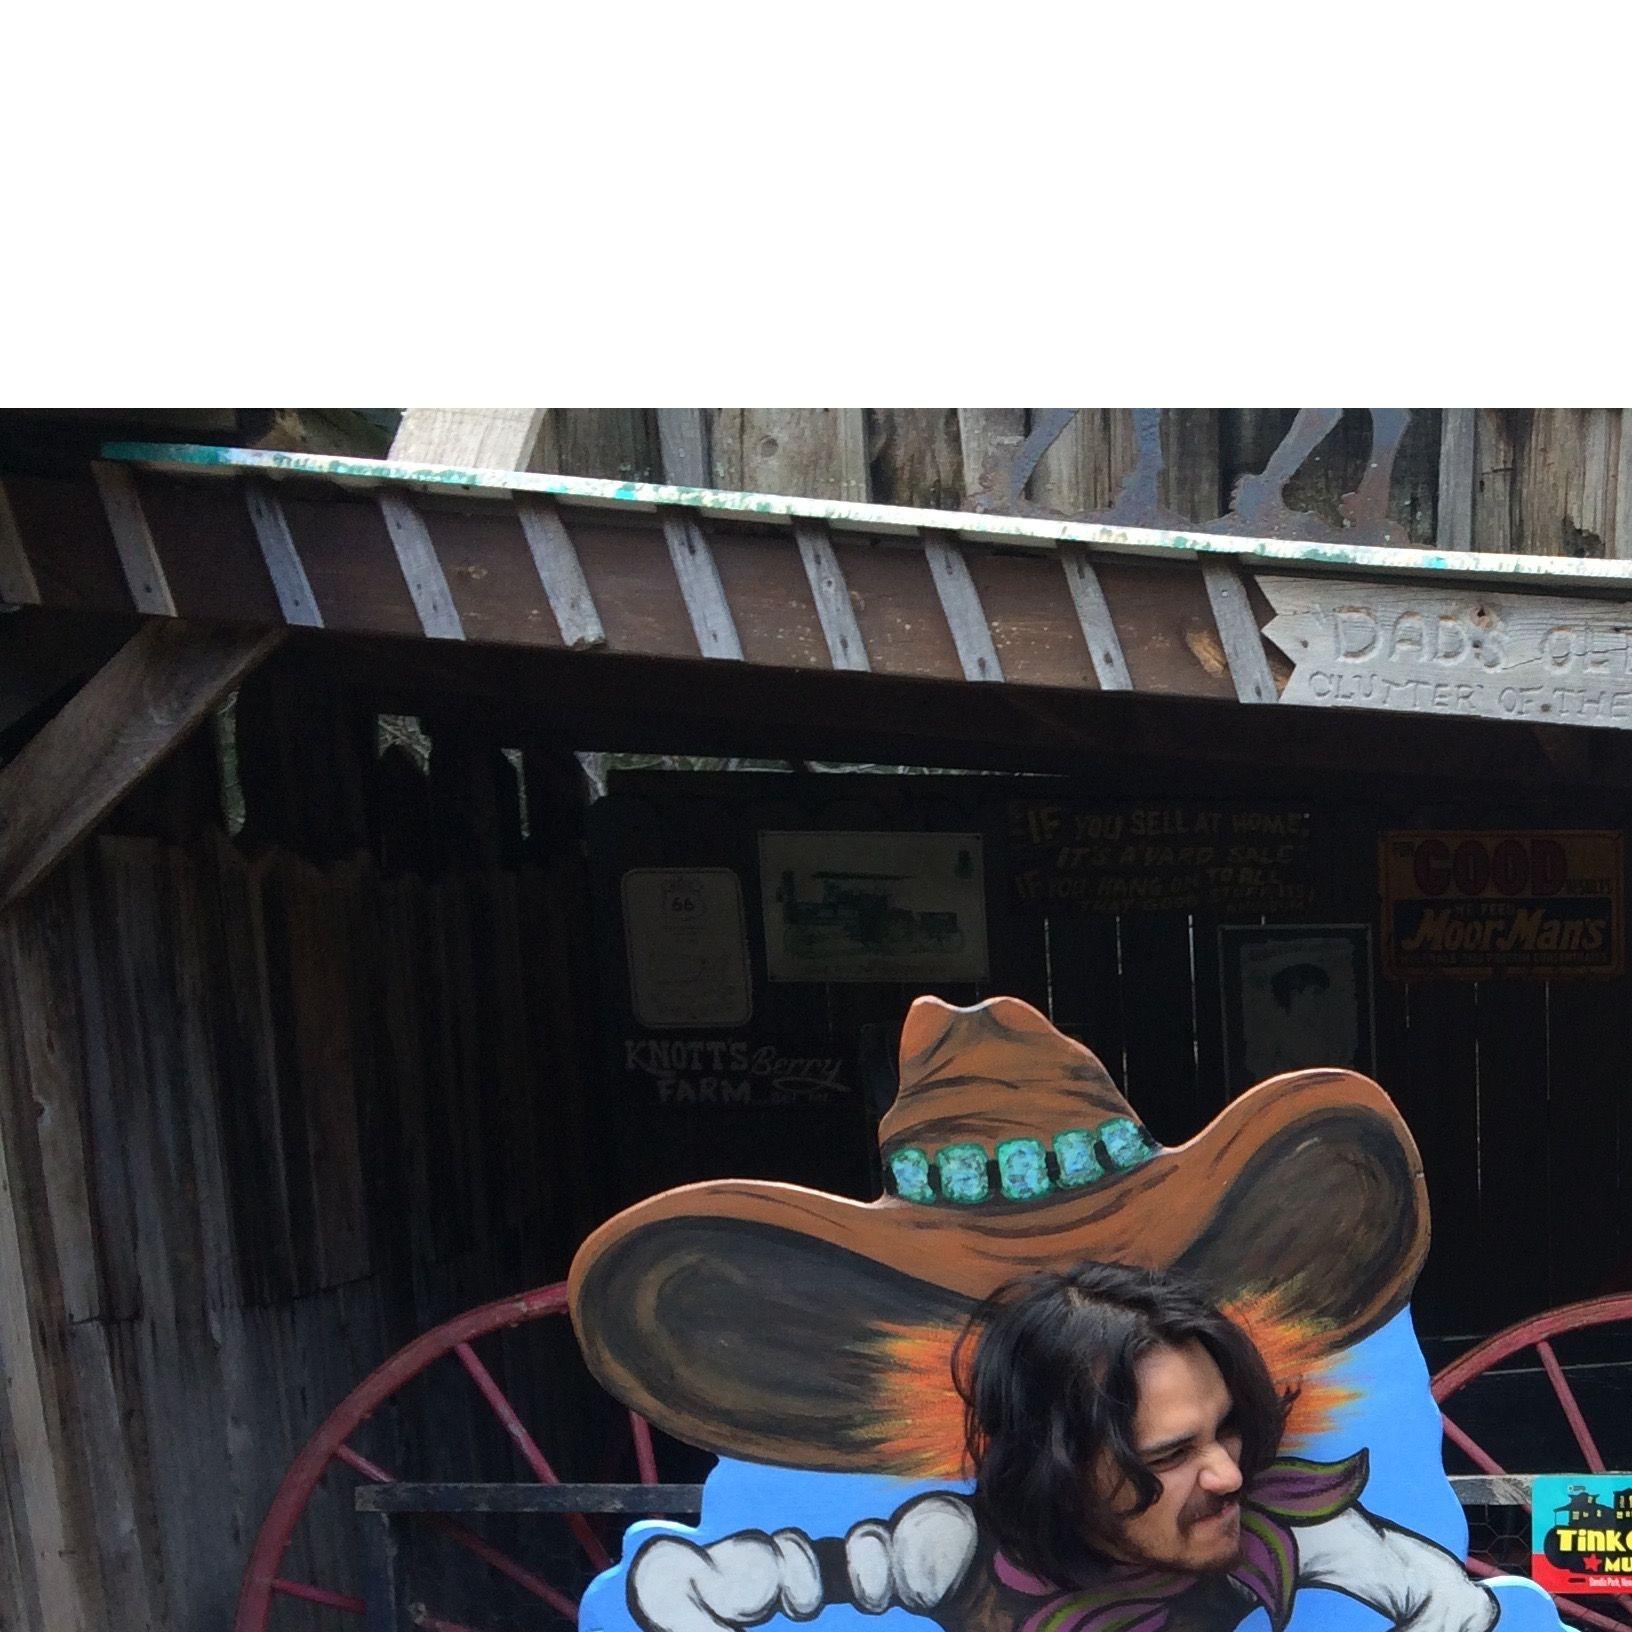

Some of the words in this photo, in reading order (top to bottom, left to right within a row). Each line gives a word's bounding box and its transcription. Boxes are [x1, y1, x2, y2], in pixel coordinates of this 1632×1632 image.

[1308, 671, 1483, 709] CLUTTER
[1499, 686, 1543, 716] OF
[1551, 686, 1632, 720] THE
[1131, 809, 1189, 836] SELL
[1194, 811, 1222, 835] AT
[1414, 839, 1566, 896] GOOD
[656, 1076, 751, 1105] FARM
